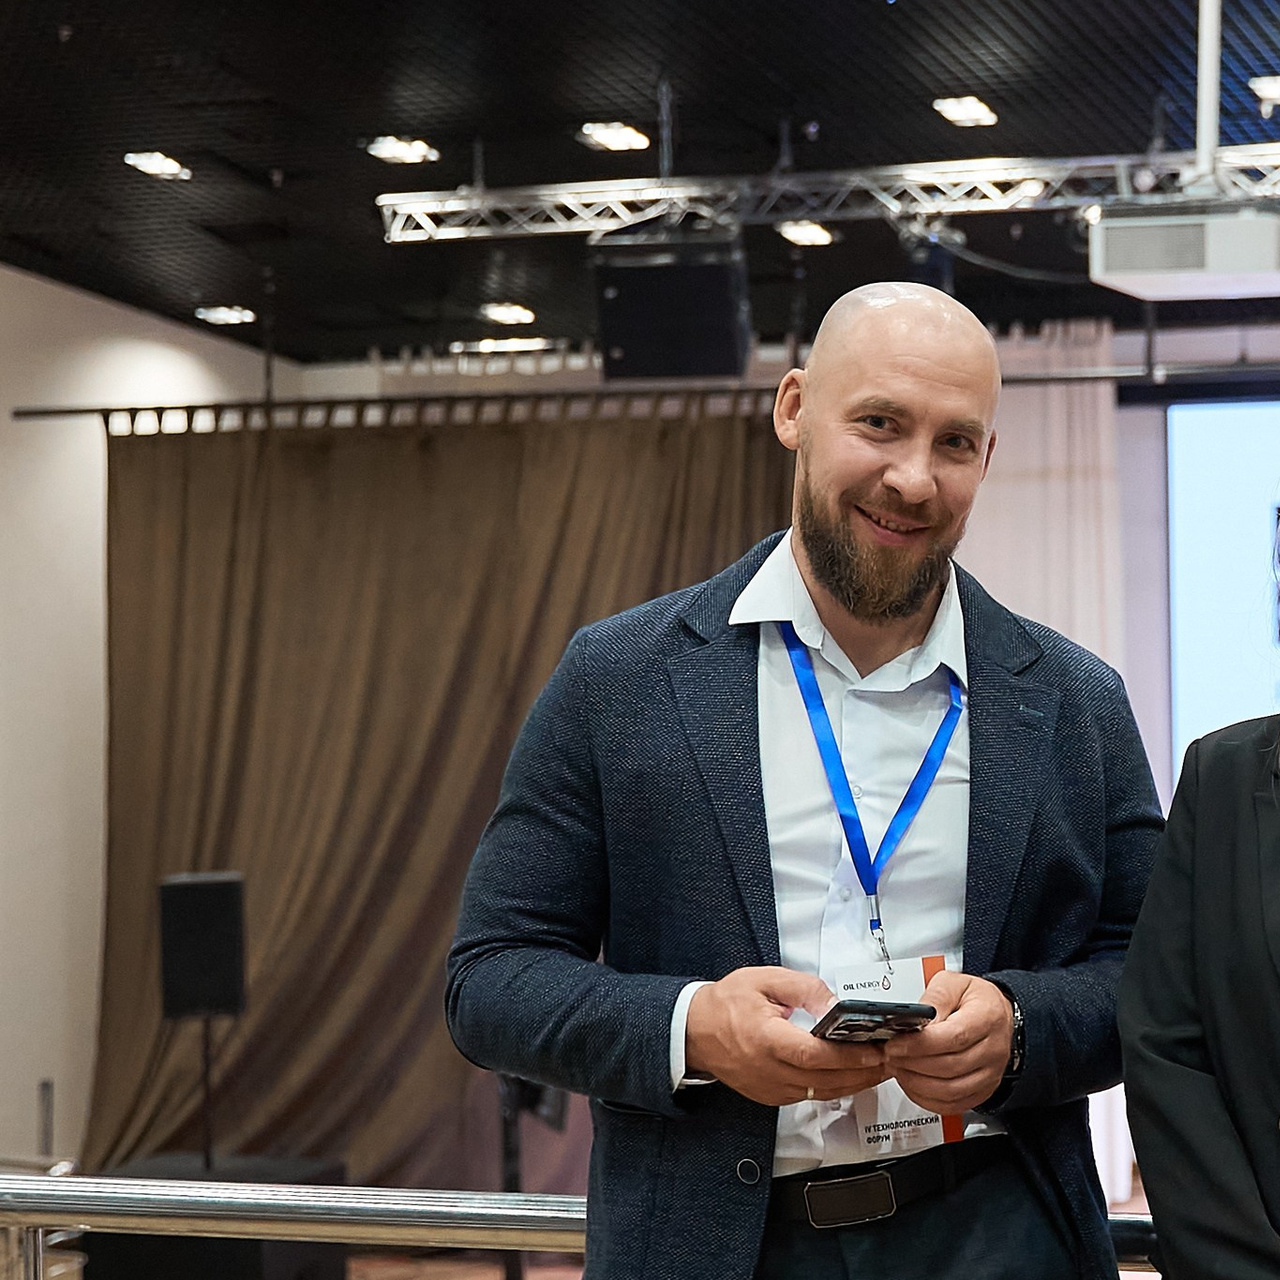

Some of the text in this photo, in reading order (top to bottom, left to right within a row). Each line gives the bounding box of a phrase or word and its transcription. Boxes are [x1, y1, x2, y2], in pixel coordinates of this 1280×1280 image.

[843, 981, 880, 991] OIL ENERGY
[872, 1114, 940, 1132] ТЕХНОЛОГИЧЕСКИЙ
[866, 1133, 891, 1144] ФОРУМ
